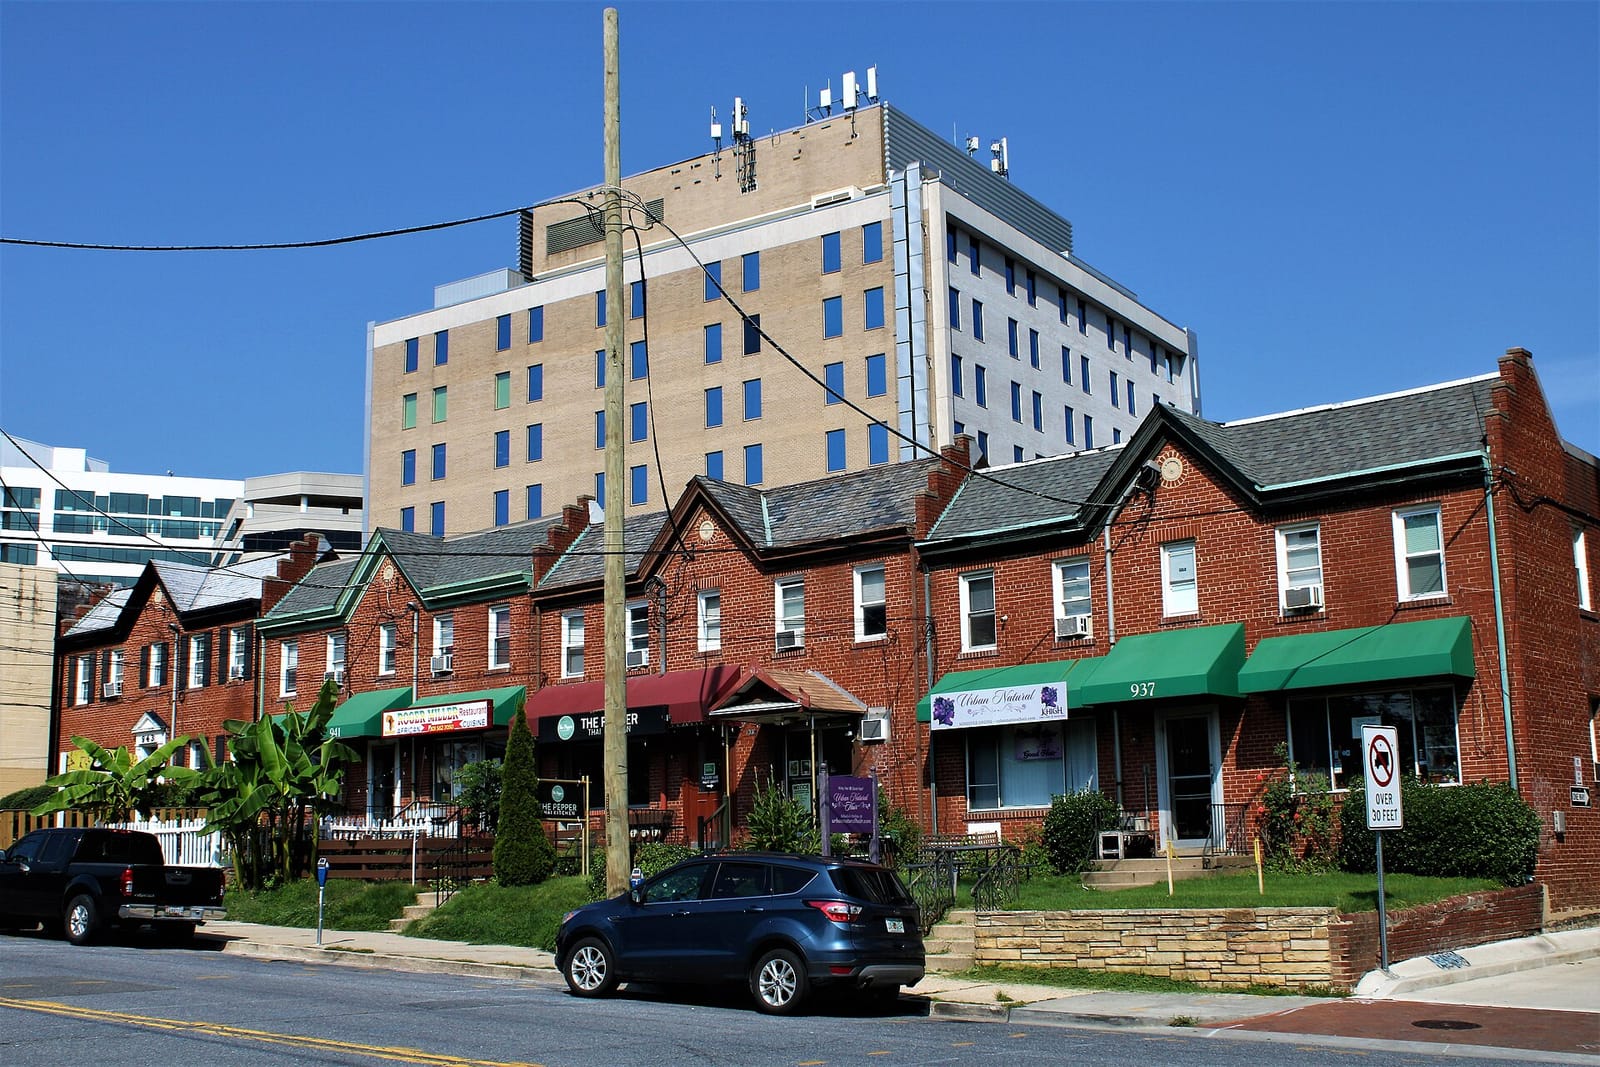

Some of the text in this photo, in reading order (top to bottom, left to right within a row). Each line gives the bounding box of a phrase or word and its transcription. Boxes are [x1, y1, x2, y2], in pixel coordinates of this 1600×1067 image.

[1130, 682, 1155, 698] 937
[956, 688, 1036, 707] Urban Natural
[397, 706, 487, 726] ROGER MILLER Restaurant
[462, 718, 486, 728] CUISINE
[580, 716, 599, 730] THE
[329, 727, 341, 738] 941
[588, 728, 601, 736] THAI
[1375, 793, 1393, 805] OVER
[542, 803, 577, 812] HE PEPPER
[1372, 808, 1398, 822] 30 FEET
